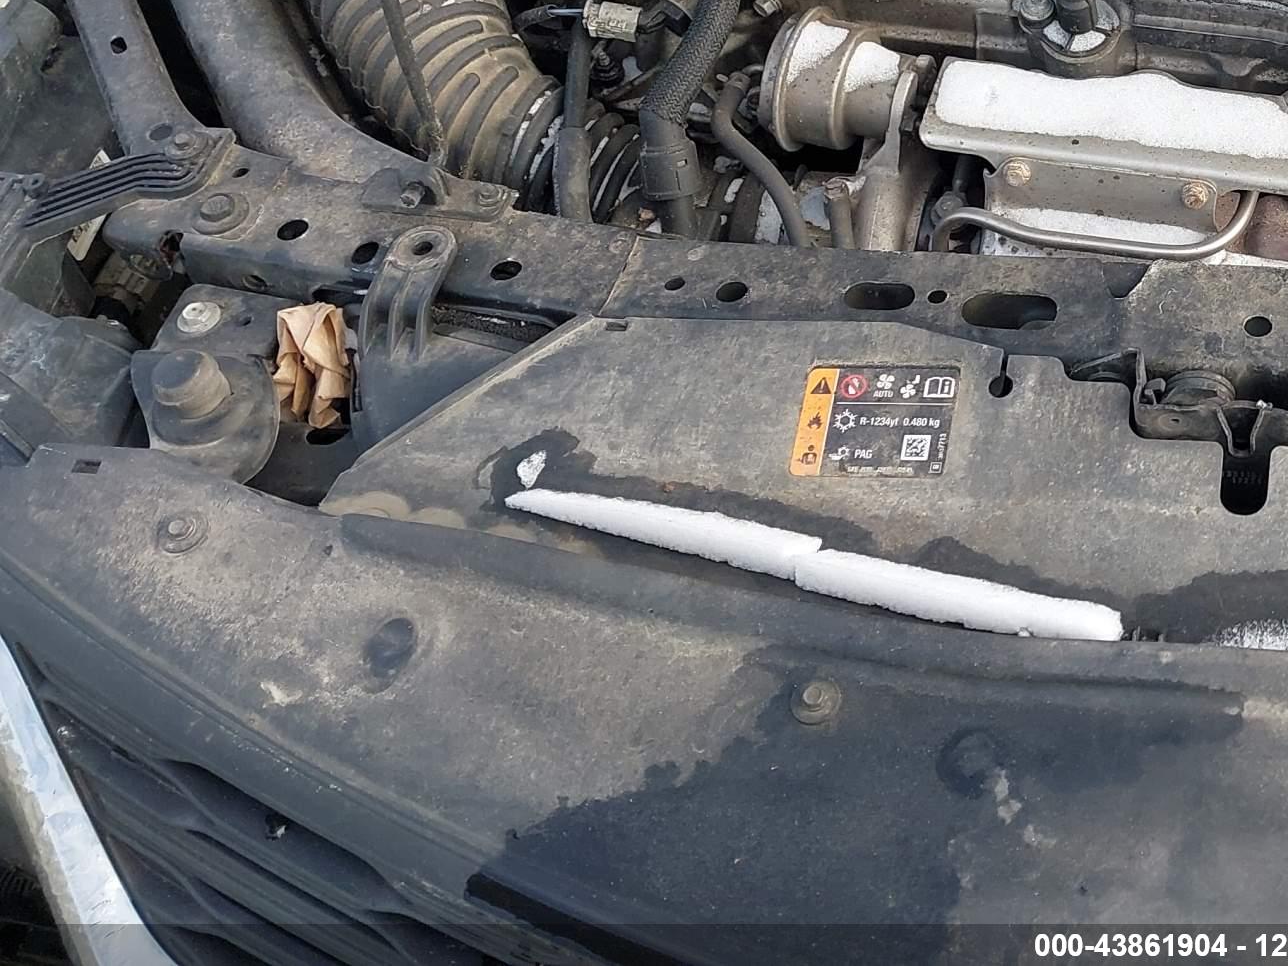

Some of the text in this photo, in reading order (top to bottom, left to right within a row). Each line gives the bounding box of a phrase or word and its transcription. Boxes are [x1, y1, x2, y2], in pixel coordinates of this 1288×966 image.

[873, 390, 894, 398] AUTO
[859, 417, 941, 429] R-1234yf 0.480 kg
[854, 449, 873, 459] PAG
